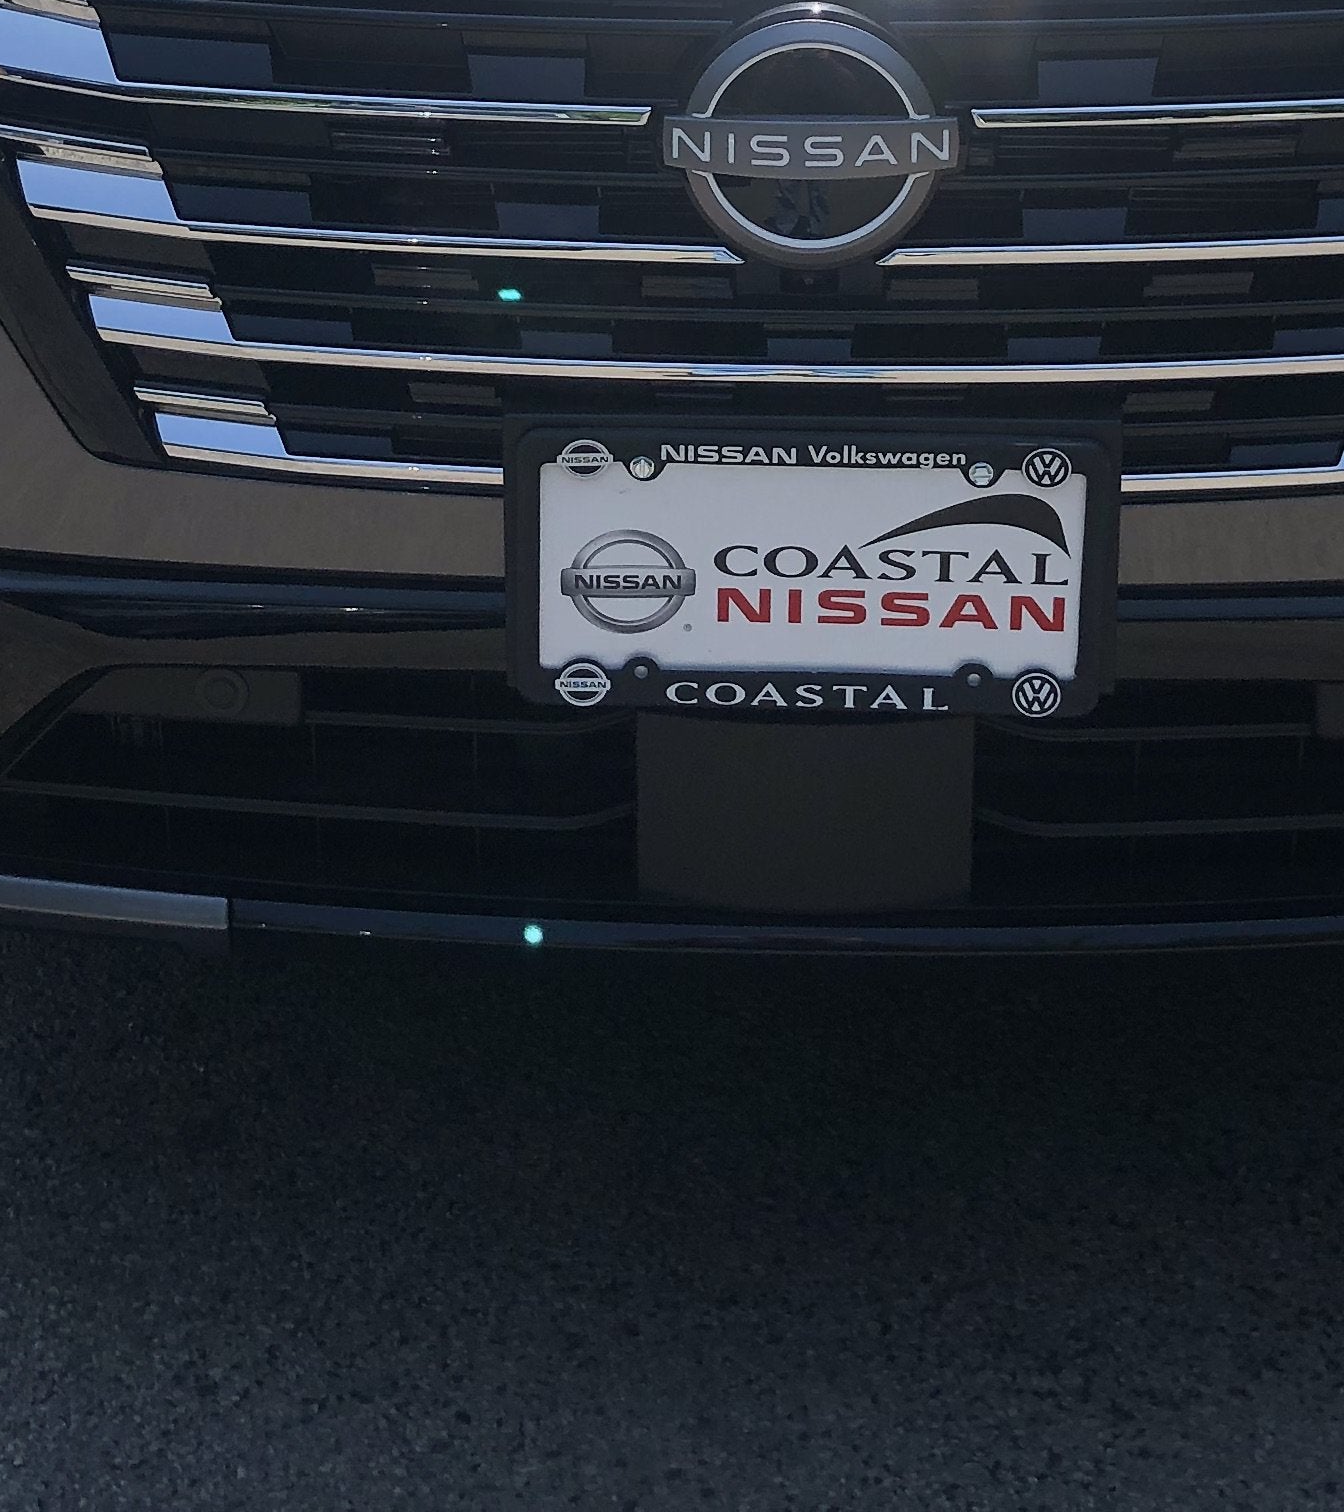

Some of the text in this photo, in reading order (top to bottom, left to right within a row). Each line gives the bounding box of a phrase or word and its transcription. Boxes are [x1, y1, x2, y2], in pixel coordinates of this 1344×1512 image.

[671, 127, 950, 168] NISSAN
[561, 455, 609, 464] NISSAN
[660, 444, 967, 469] NISSAN Volkswagen
[713, 544, 1069, 586] COASTAL
[573, 573, 683, 591] NISSAN
[716, 587, 1066, 633] NISSAN
[559, 680, 607, 690] NISSAN
[665, 681, 949, 711] COASTAL
